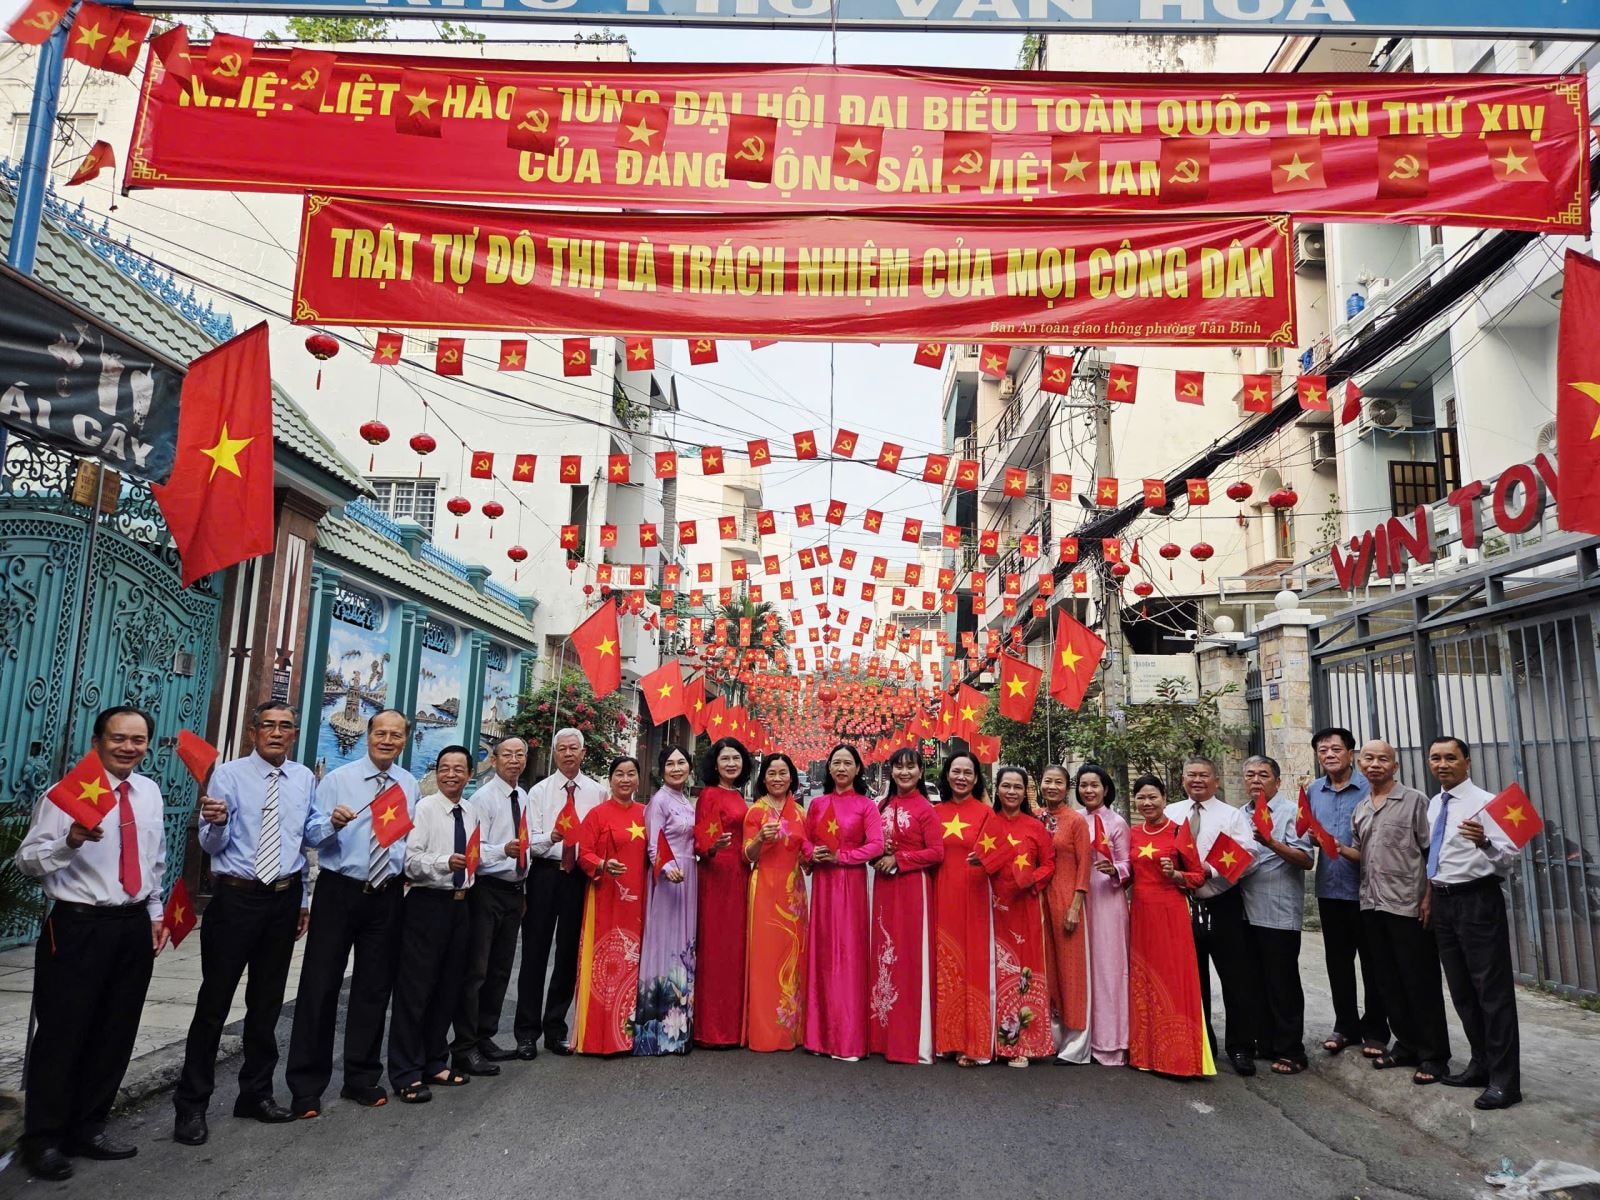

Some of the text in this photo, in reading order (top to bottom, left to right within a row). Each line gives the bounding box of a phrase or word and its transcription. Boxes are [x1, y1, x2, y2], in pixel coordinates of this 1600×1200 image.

[441, 77, 517, 120] HÀO
[674, 91, 743, 134] ĐẠI
[757, 86, 825, 136] HỘI
[923, 86, 1018, 132] BIỂU
[1032, 94, 1143, 134] TOÀN
[1157, 93, 1271, 138] QUỐC
[1286, 91, 1370, 136] LẦN
[1382, 95, 1468, 139] THỨ
[1477, 103, 1546, 142] XIV
[518, 136, 602, 184] CỦA
[746, 147, 860, 198] ỘN
[331, 223, 1275, 309] TRẬT TỰ ĐÔ THỊ LÀ TRÁCH NHIỆM CỦA MỌI CÔNG DÂN
[990, 320, 1261, 336] Ban An toàn giao thông phường Tân Bình
[72, 414, 153, 468] CÂY
[1330, 453, 1559, 592] WIN TO
